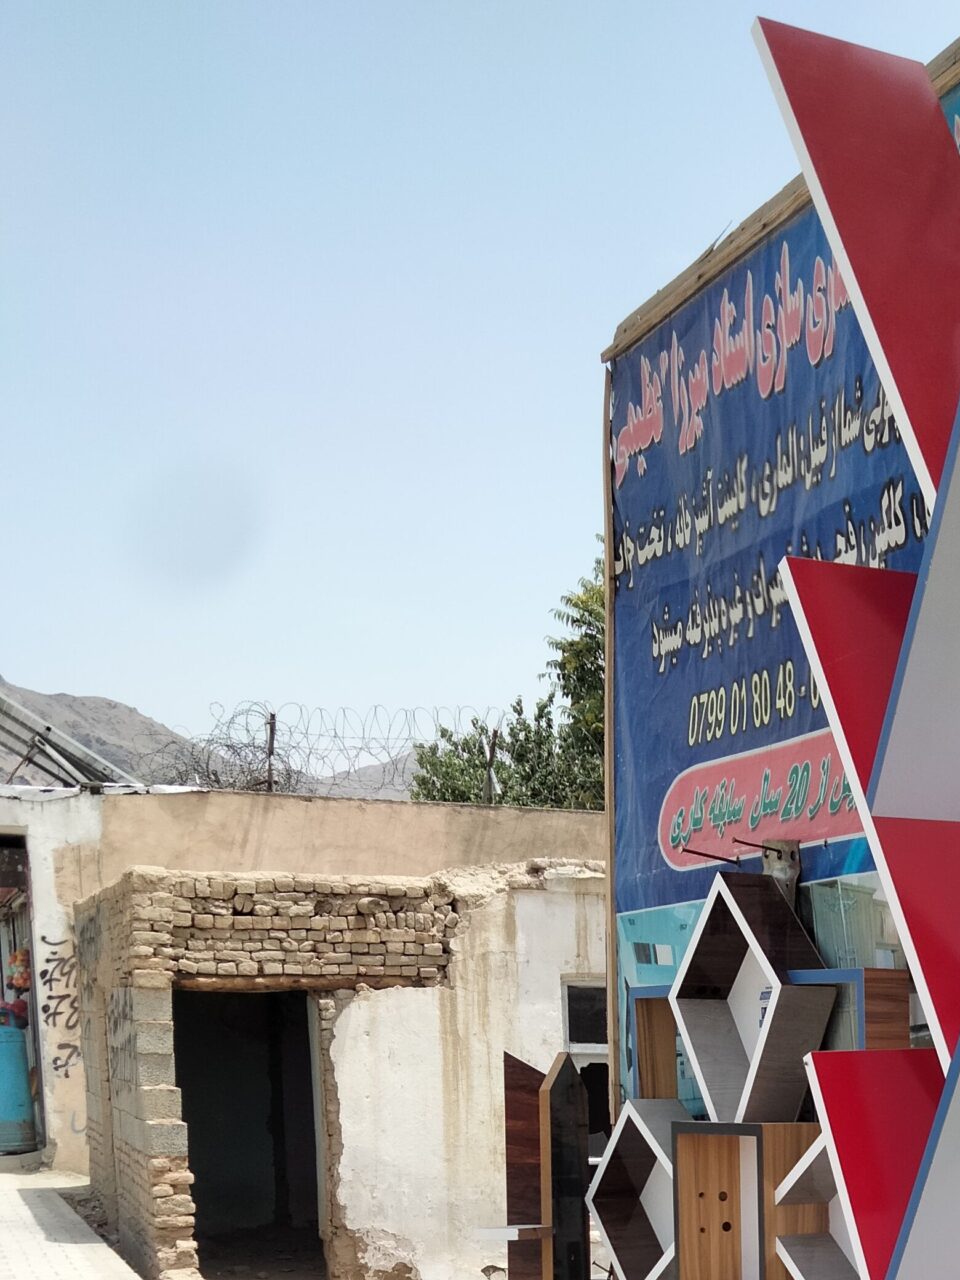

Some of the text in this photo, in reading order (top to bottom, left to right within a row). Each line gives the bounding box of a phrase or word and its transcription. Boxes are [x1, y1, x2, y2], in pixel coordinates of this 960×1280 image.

[712, 269, 753, 396] استاد
[757, 240, 804, 399] سازی
[671, 330, 709, 456] میرزا
[841, 376, 863, 446] شما
[829, 393, 840, 478] از
[758, 424, 798, 517] الماری
[636, 510, 664, 565] تخت
[675, 493, 692, 549] خانه
[652, 606, 683, 672] میشود
[688, 686, 726, 747] 0799
[730, 678, 747, 735] 01
[752, 669, 771, 728] 80
[775, 660, 795, 719] 48
[670, 787, 707, 847] کاری
[708, 778, 746, 838] سابقه
[749, 769, 782, 829] سال
[780, 761, 811, 821] 20
[808, 753, 831, 817] از
